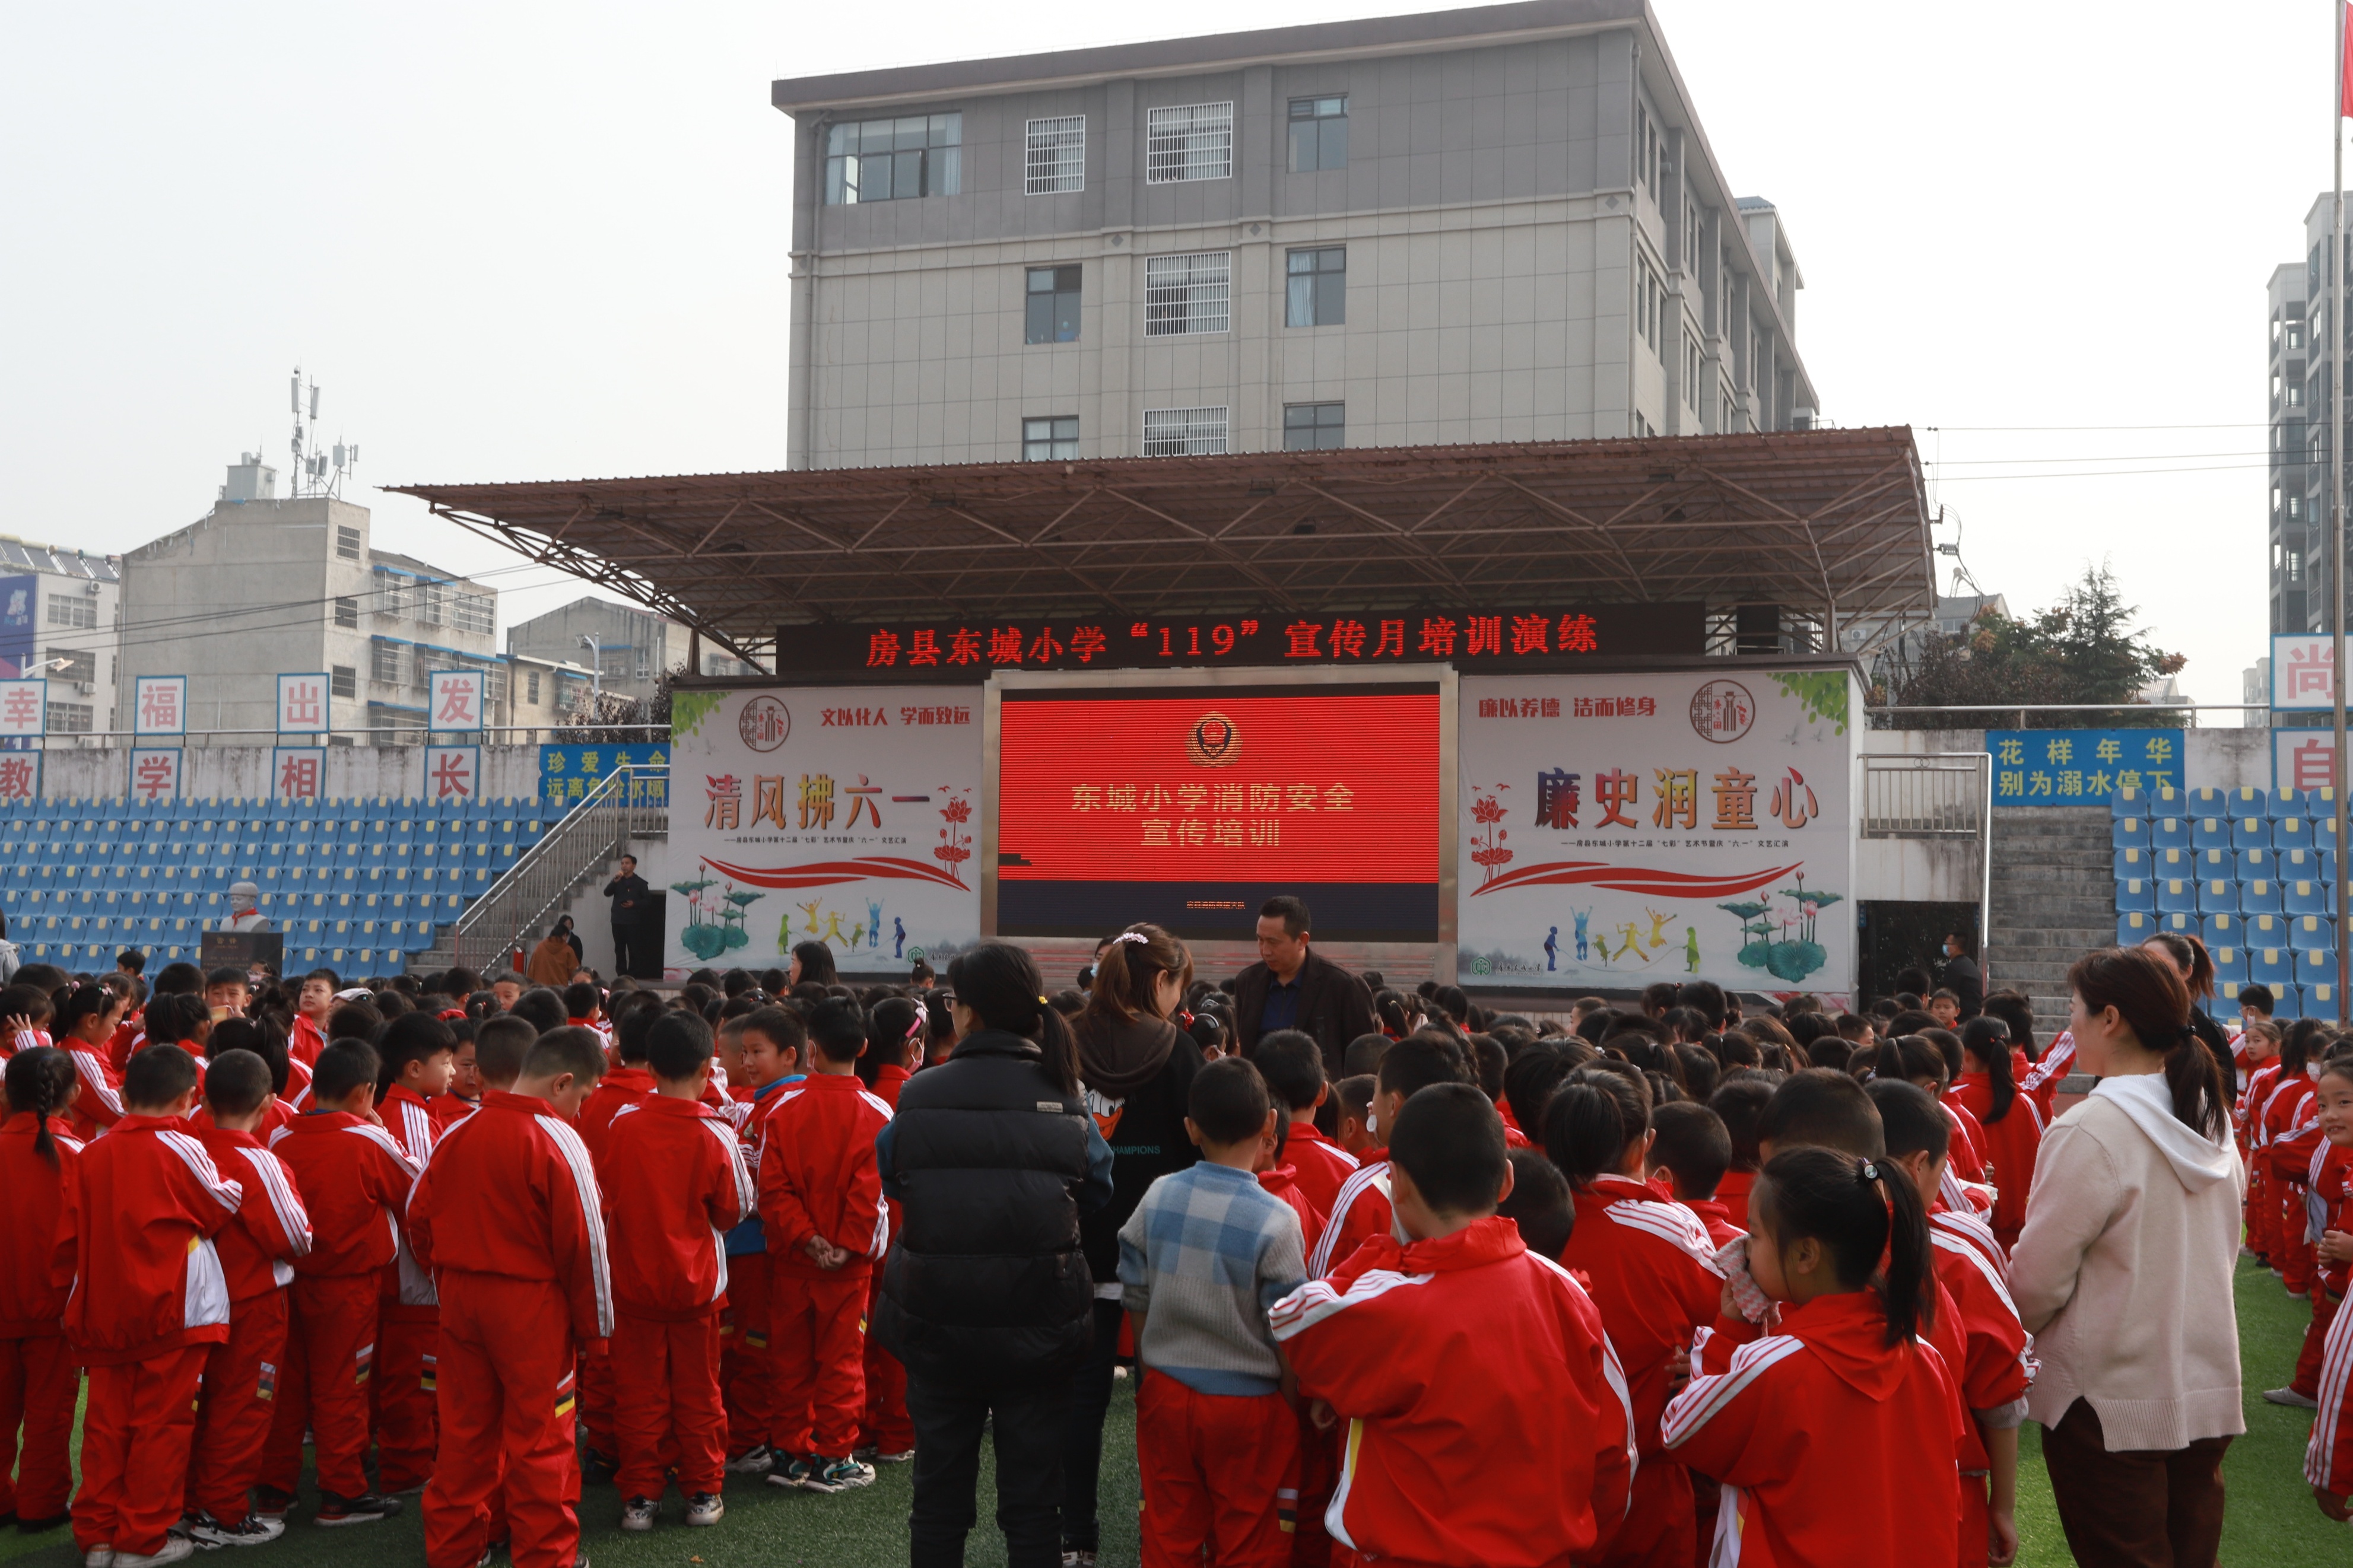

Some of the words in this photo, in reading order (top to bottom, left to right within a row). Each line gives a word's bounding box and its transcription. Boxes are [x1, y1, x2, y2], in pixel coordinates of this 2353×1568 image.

[2288, 644, 2335, 699] 尚
[4, 688, 38, 729] 幸
[142, 685, 177, 727] 福
[287, 682, 319, 724] 出
[437, 679, 474, 723] 发
[821, 707, 888, 727] 文以化人
[900, 706, 970, 726] 学而致远
[1478, 696, 1560, 718] 廉以养德
[1574, 696, 1657, 717] 洁而修身
[547, 750, 666, 773] 珍爱生命
[1998, 737, 2173, 765] 花样年华
[2294, 739, 2336, 792] 自
[0, 758, 34, 799] 教
[137, 756, 172, 799] 学
[280, 755, 317, 798] 相
[431, 753, 469, 798] 长
[704, 773, 930, 830] 清风拂六一
[1071, 783, 1354, 812] 东城小学消防安全
[1535, 765, 1818, 830] 廉史润童心
[1141, 818, 1281, 847] 宣传培训
